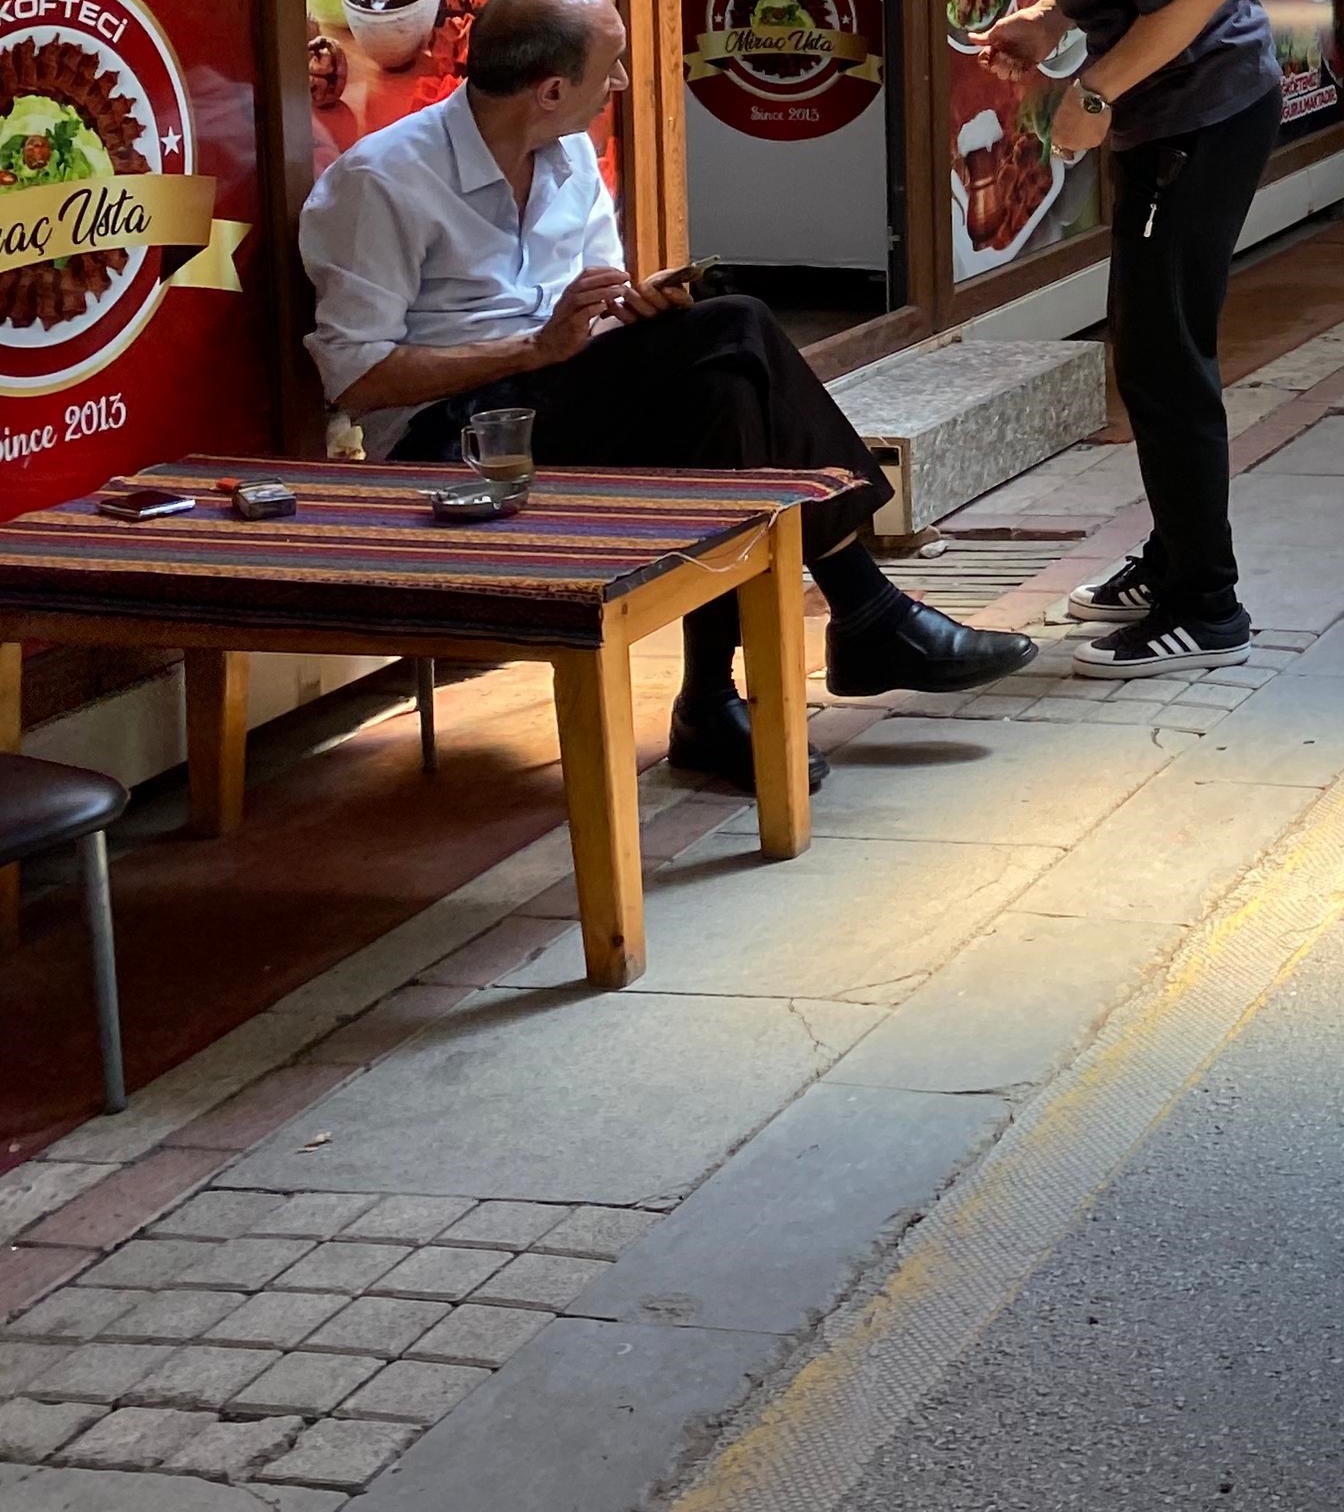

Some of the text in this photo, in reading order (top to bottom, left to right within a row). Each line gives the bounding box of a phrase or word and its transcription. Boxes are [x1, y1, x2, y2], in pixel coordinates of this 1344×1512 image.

[788, 29, 836, 53] Usta
[750, 105, 785, 121] Since
[58, 186, 152, 247] Usta
[64, 393, 127, 442] 2013
